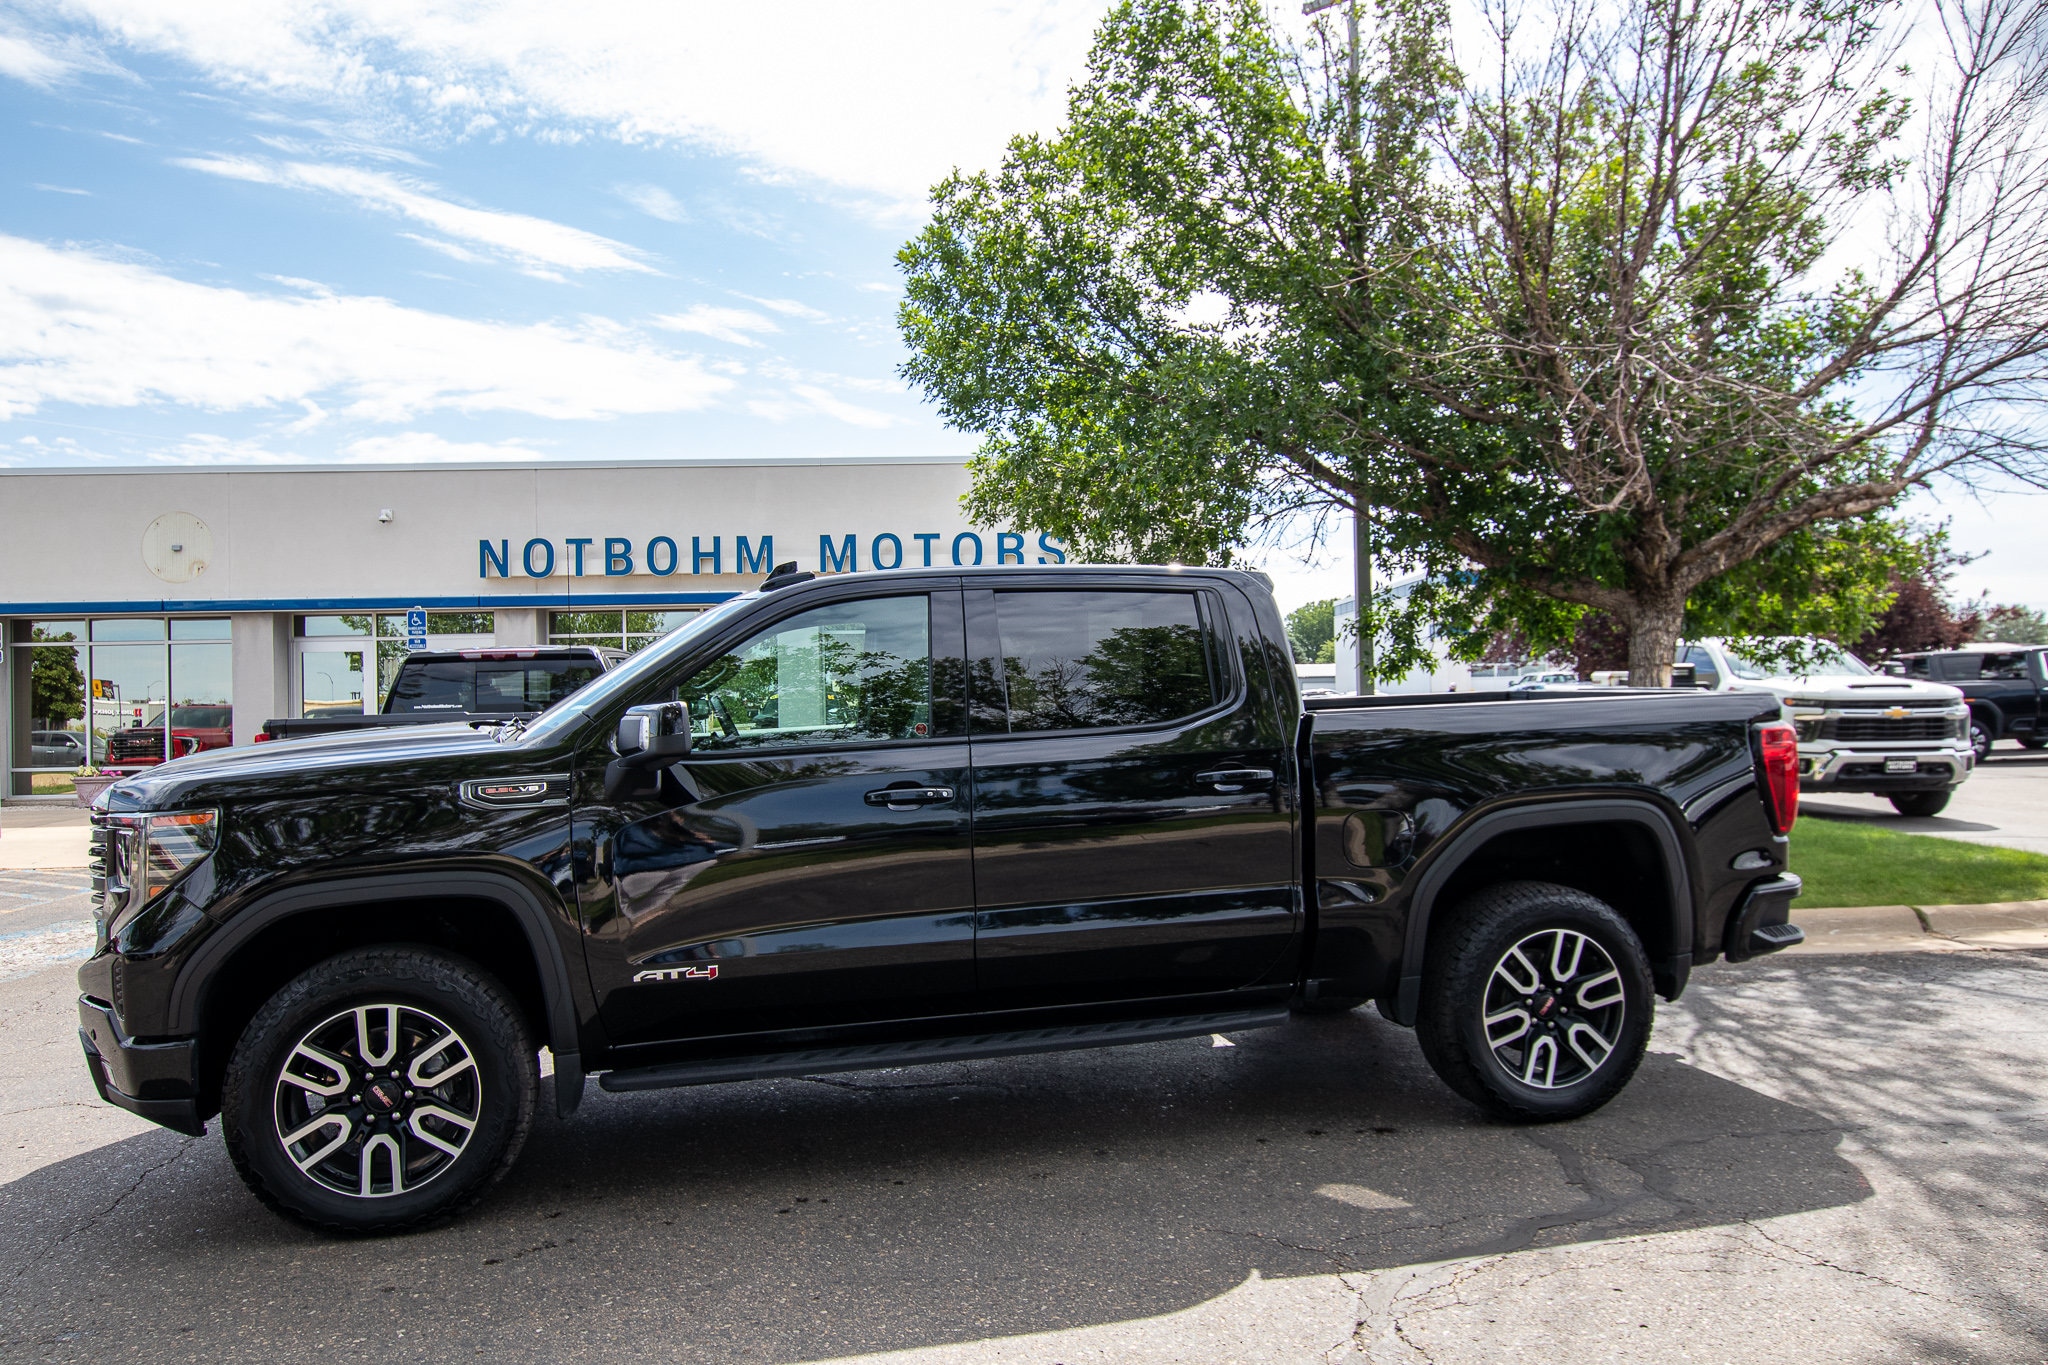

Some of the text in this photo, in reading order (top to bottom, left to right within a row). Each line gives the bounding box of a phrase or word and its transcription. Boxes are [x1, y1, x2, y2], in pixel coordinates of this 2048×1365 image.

[479, 531, 1067, 579] NOTBOHM MOTORS
[633, 964, 719, 983] AT4
[372, 1085, 394, 1108] GMC
